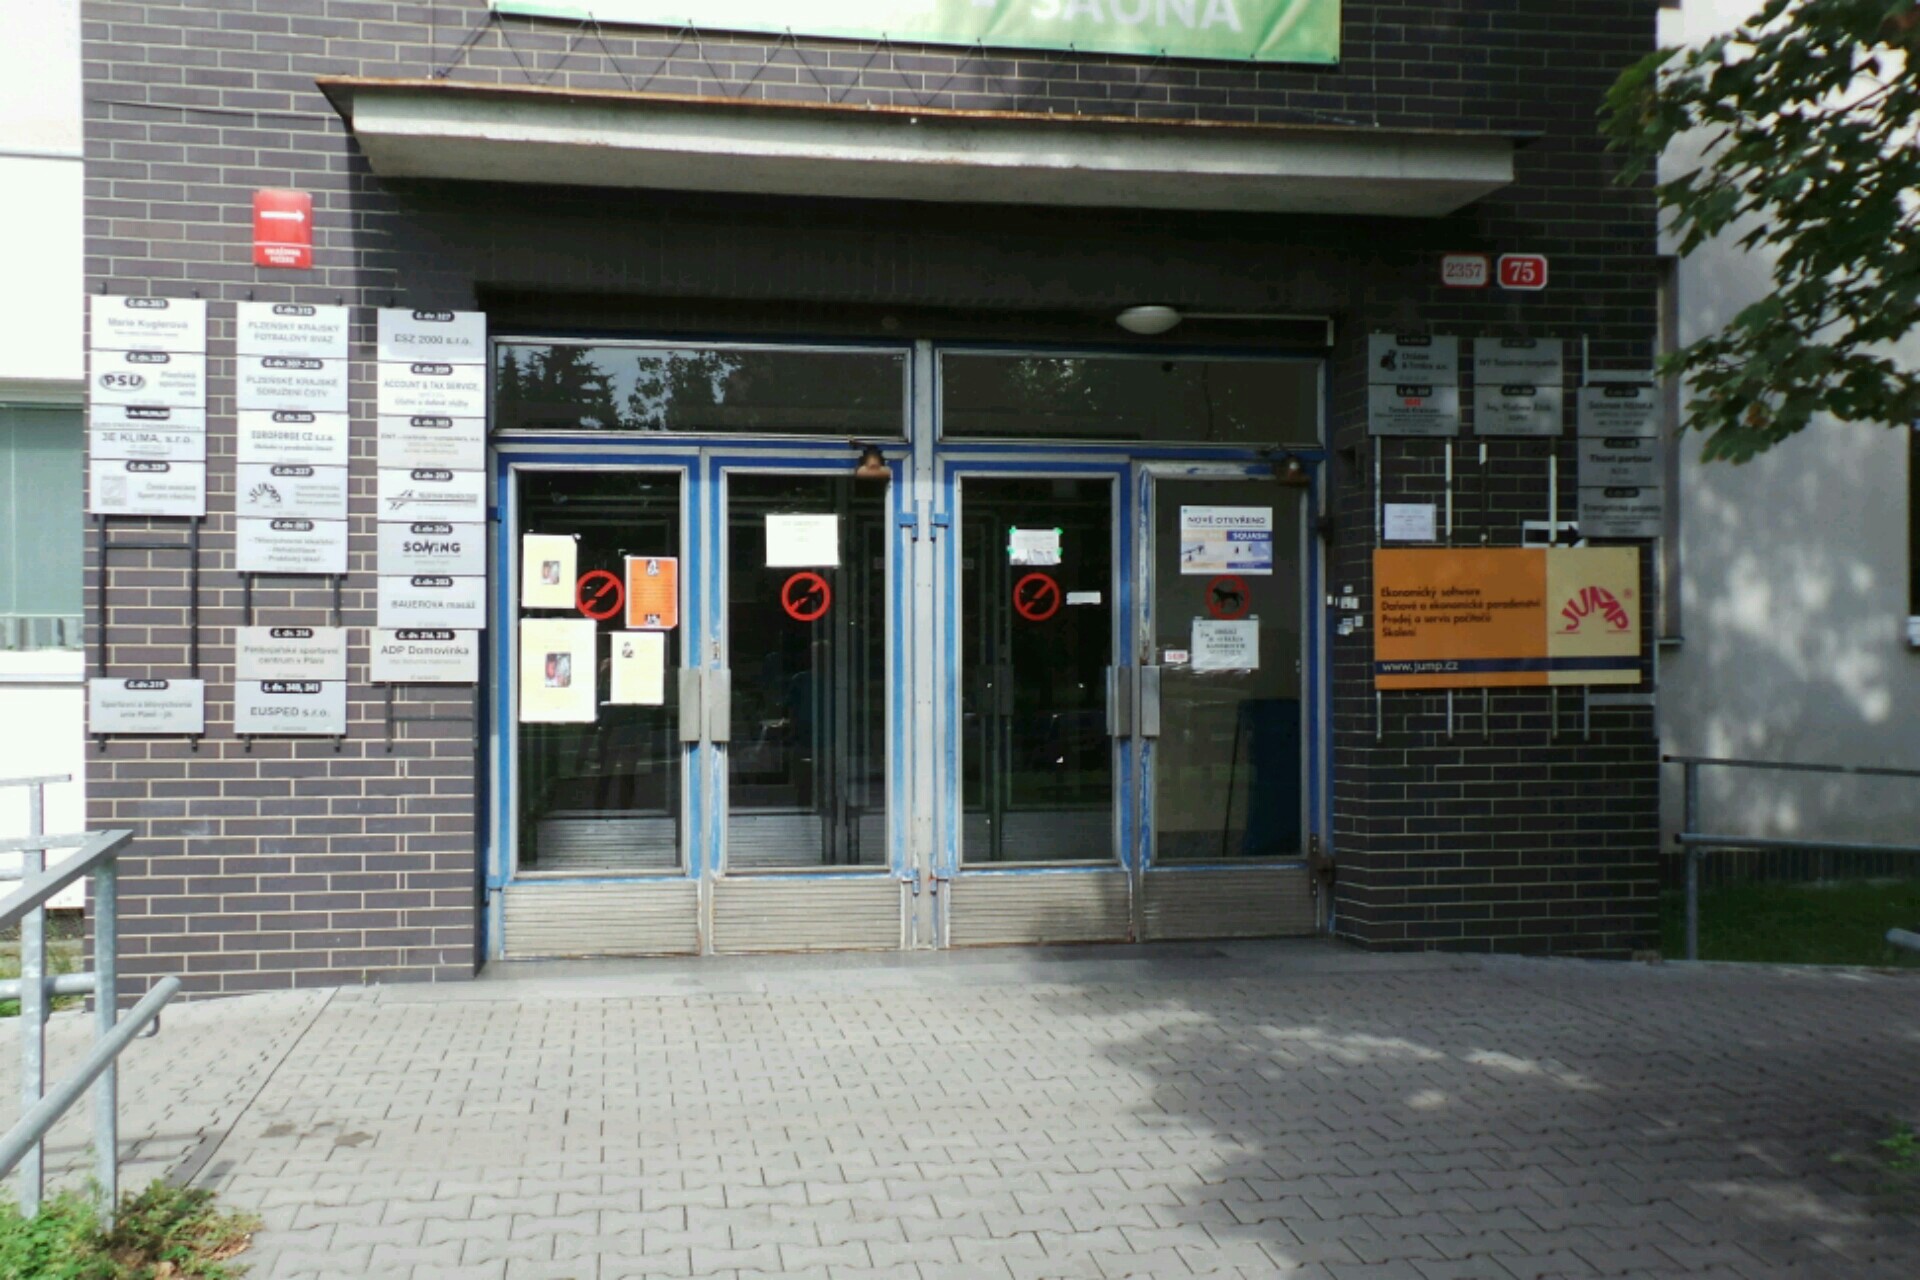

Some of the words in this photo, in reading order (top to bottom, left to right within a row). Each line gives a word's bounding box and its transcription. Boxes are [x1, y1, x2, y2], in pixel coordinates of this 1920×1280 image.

[1445, 262, 1483, 278] 2357
[1510, 261, 1535, 282] 75
[108, 317, 135, 327] Marie
[394, 333, 416, 344] ESZ
[418, 335, 444, 345] 2000
[103, 373, 143, 386] PSU
[384, 379, 421, 390] ACCOUNT
[302, 432, 313, 441] CZ
[1215, 515, 1266, 525] OTEVŘENO
[1232, 531, 1269, 541] SQUASH
[1380, 587, 1437, 599] Ekonomický
[1441, 587, 1481, 597] software
[1381, 600, 1417, 611] Daňové
[1429, 600, 1483, 610] ekonomické
[1486, 598, 1541, 610] poradenství
[1561, 585, 1629, 631] JUMP
[1382, 614, 1412, 626] Prodej
[1424, 615, 1451, 624] servis
[1453, 612, 1492, 625] počítačů
[1382, 625, 1416, 637] Školení
[381, 645, 406, 656] ADP
[1382, 661, 1459, 673] www.jump.cz
[250, 706, 299, 717] EUSPED
